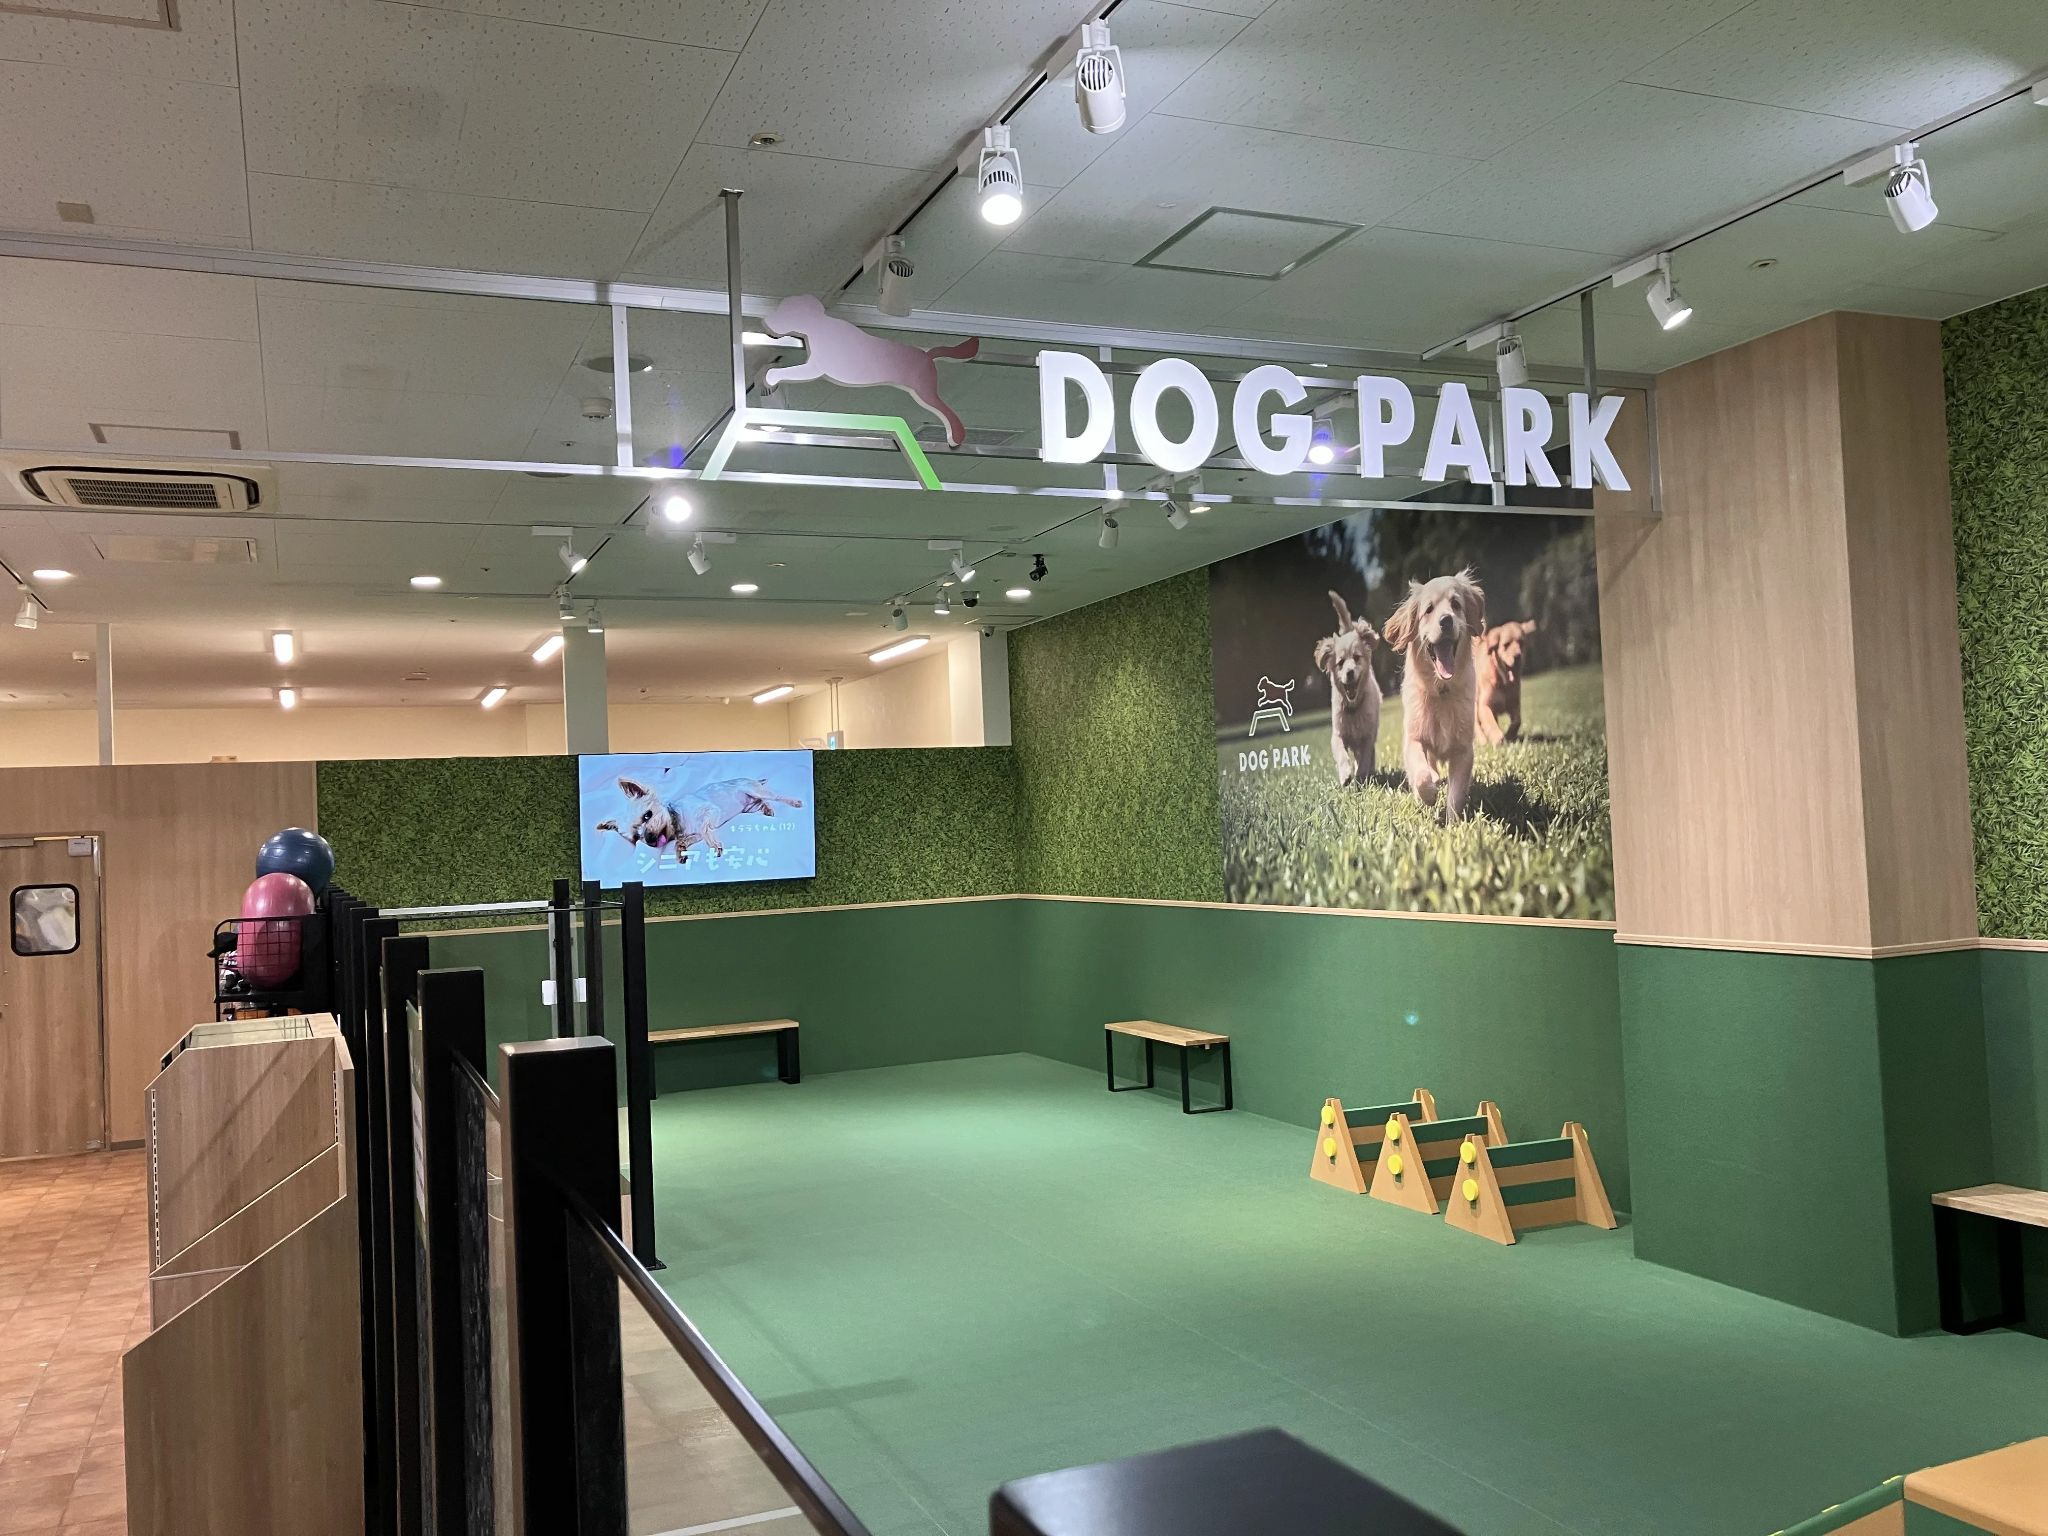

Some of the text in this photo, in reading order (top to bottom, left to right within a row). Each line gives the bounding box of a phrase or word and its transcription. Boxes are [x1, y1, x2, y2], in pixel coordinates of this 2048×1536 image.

[1038, 350, 1632, 491] DOG PARK
[1239, 745, 1310, 772] DOG PARK
[637, 845, 770, 874] シニアも安心
